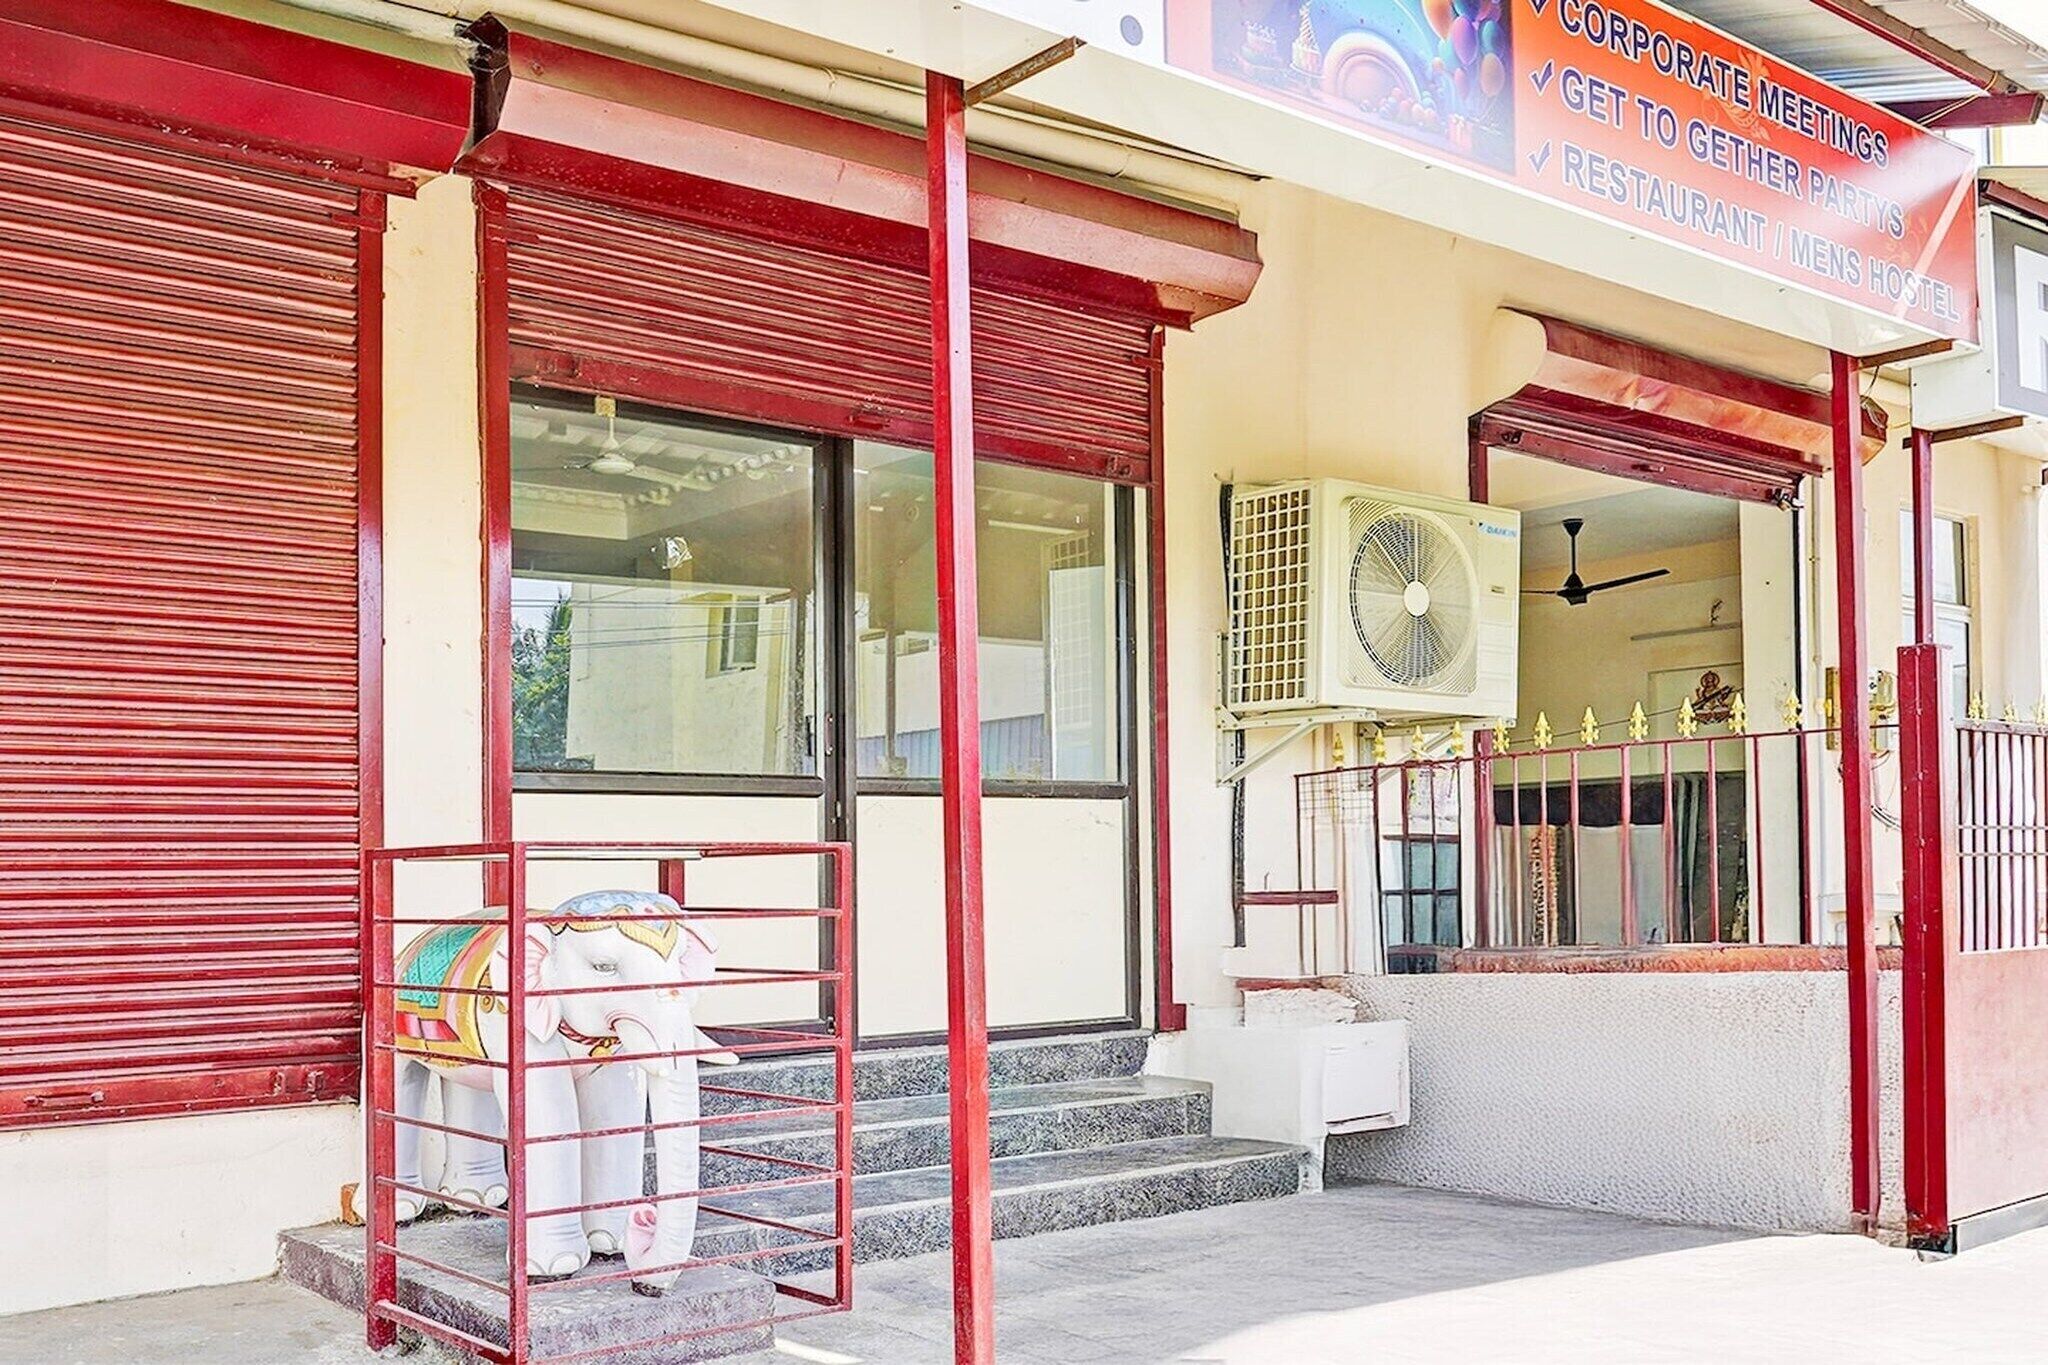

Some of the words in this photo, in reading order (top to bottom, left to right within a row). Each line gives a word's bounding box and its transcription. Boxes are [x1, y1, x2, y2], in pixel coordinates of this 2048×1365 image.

[1559, 0, 1749, 107] CORPORATE
[1759, 80, 1888, 168] MEETINGS
[1561, 69, 1627, 126] GET
[1637, 98, 1677, 147] TO
[1688, 120, 1801, 197] GETHER
[1810, 169, 1904, 239] PARTYS
[1563, 144, 1766, 250] RESTAURANT
[1774, 222, 1783, 258] /
[1791, 228, 1861, 286] MENS
[1869, 258, 1959, 321] HOSTEL
